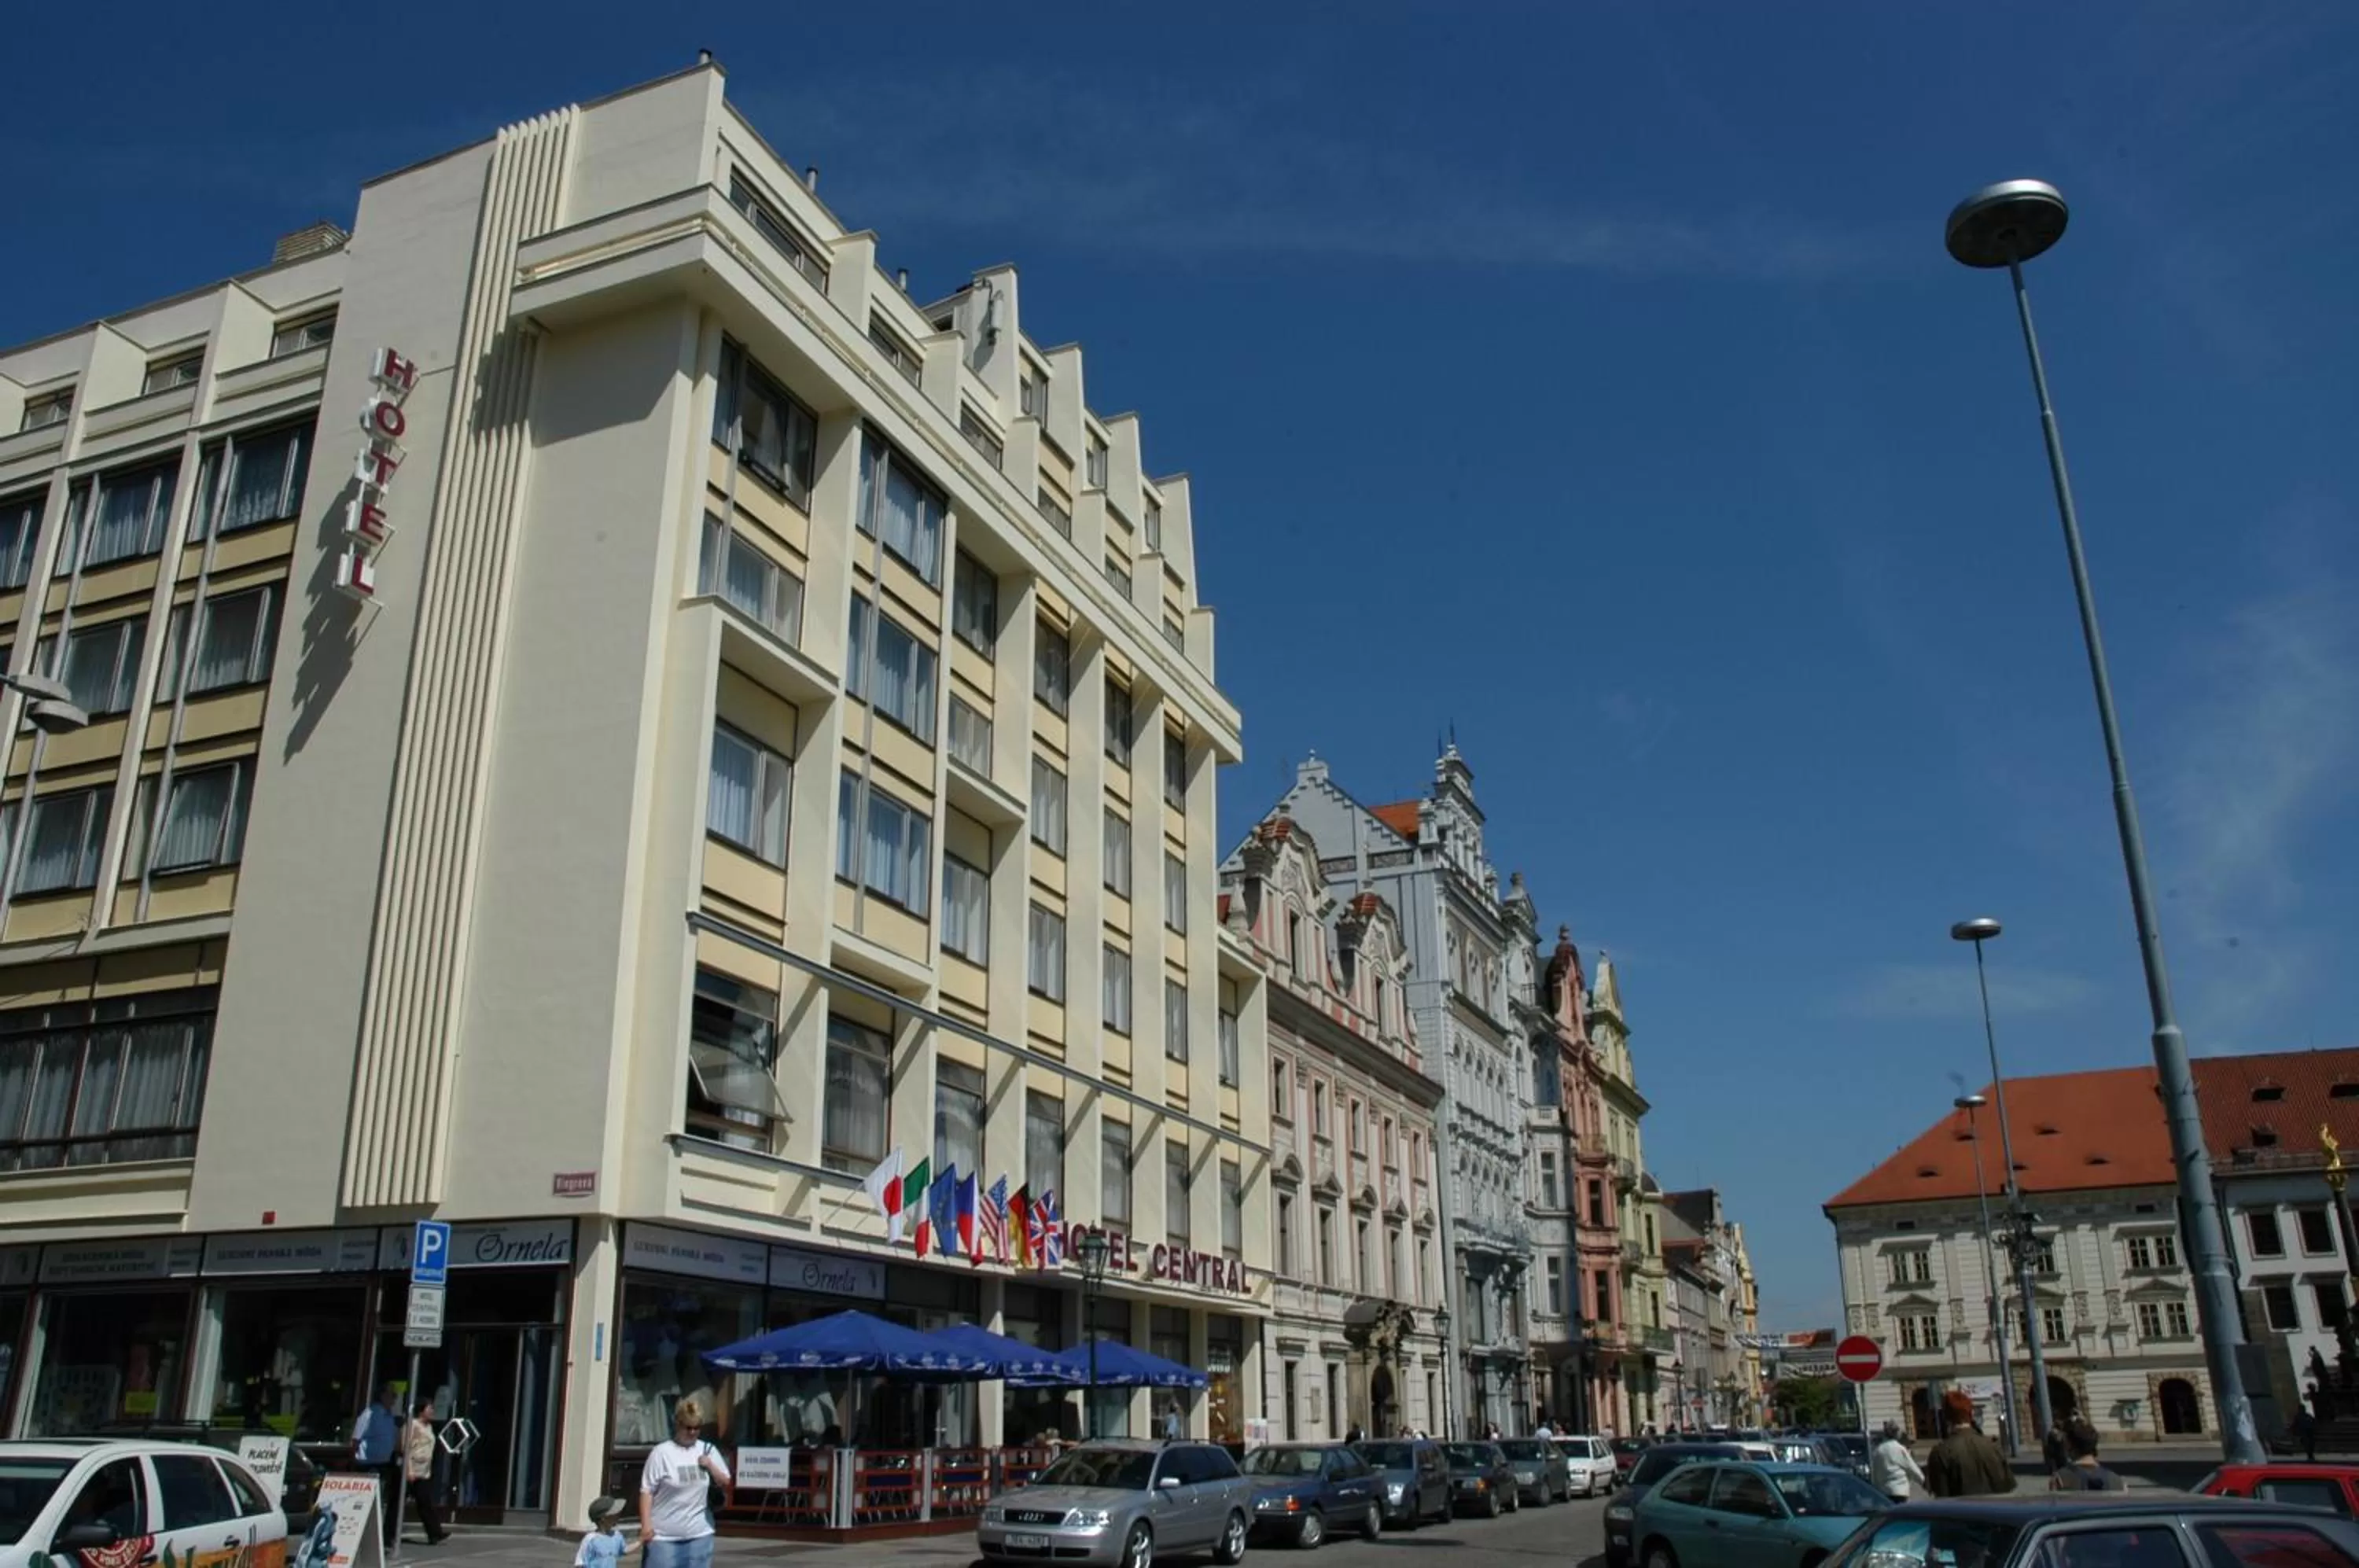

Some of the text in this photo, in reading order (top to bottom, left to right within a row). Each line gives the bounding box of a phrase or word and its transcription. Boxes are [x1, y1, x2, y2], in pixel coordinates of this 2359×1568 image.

[351, 346, 415, 598] HOTEL
[421, 1228, 443, 1264] P
[475, 1231, 569, 1262] Ornela
[802, 1262, 856, 1294] Ornela
[1152, 1242, 1252, 1294] CENTRAL
